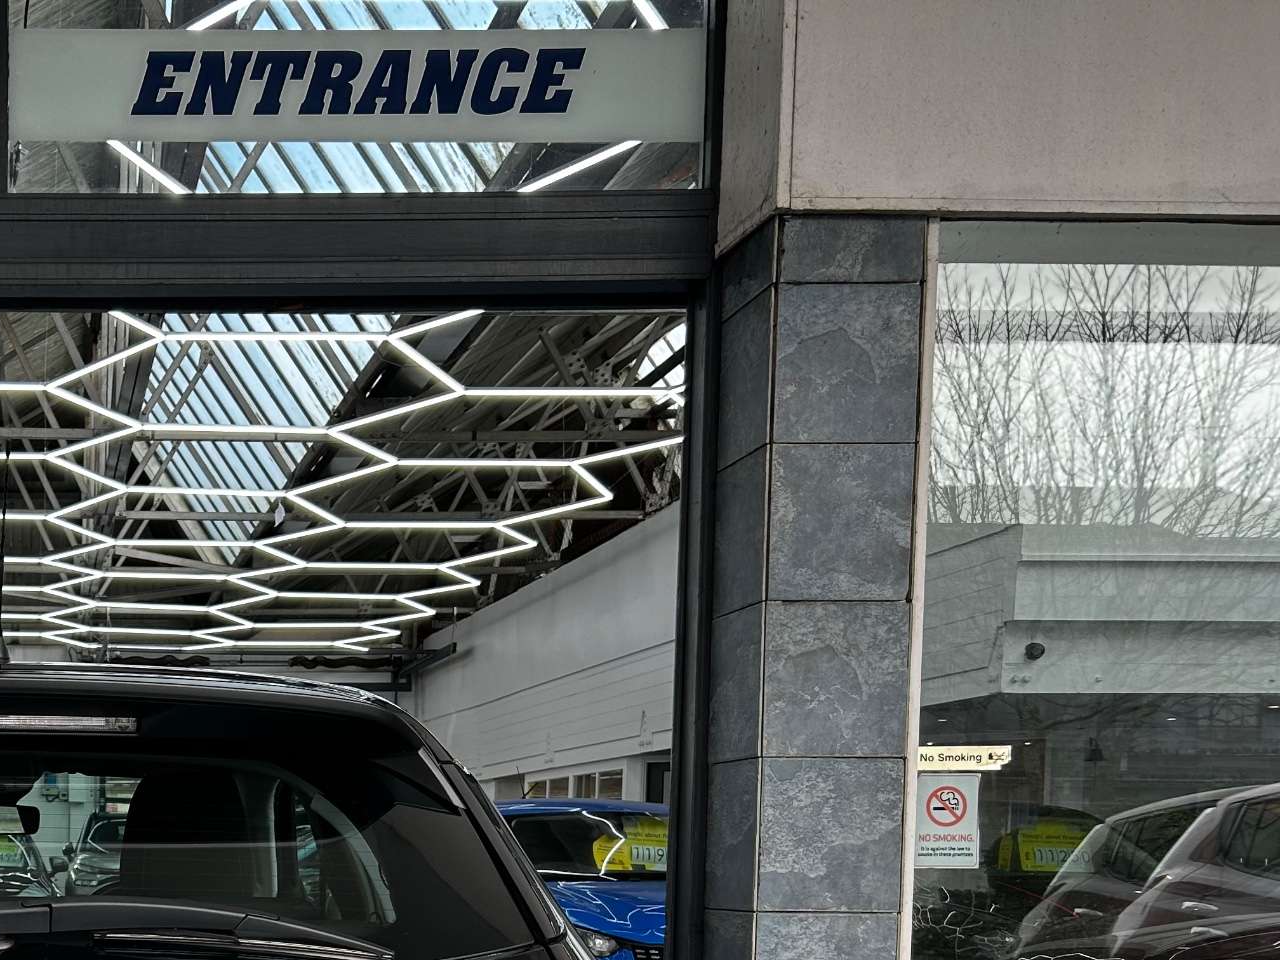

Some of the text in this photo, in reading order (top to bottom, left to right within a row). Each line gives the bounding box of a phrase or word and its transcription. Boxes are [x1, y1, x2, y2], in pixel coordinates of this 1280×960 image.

[130, 47, 587, 116] ENTRANCE
[919, 752, 982, 763] No Smoking
[918, 833, 931, 842] NO
